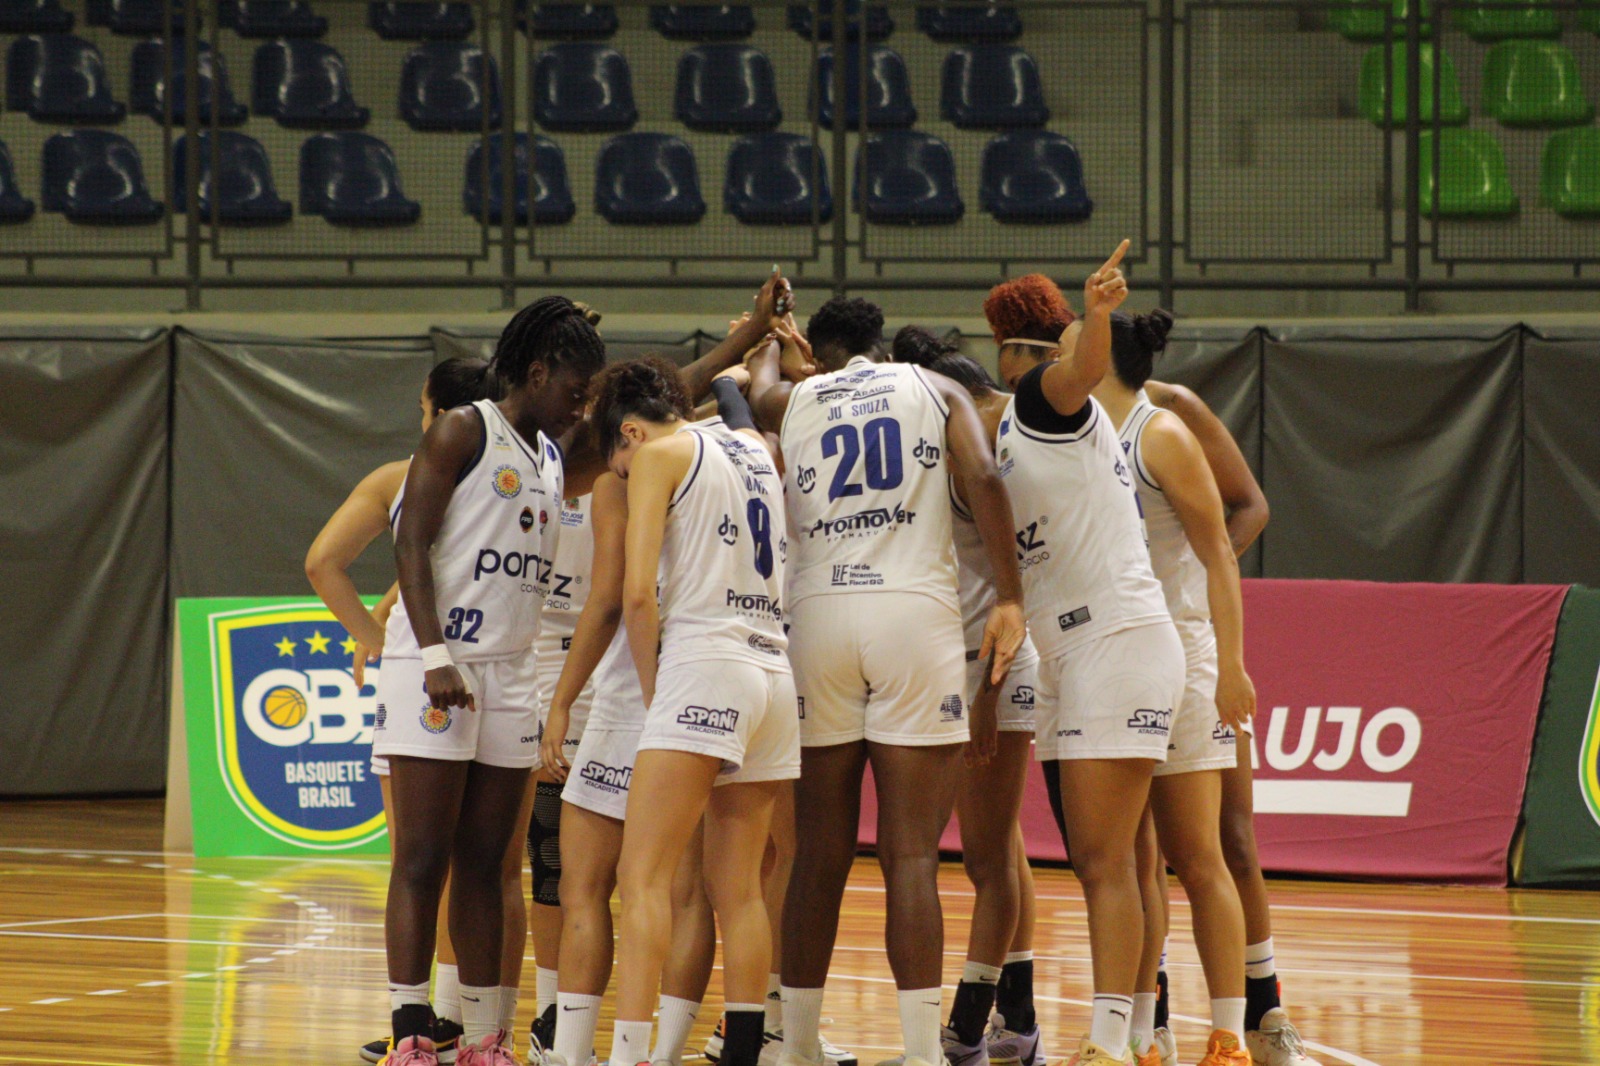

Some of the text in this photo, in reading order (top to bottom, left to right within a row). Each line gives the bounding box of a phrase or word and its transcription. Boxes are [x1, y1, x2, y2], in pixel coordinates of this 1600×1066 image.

[827, 398, 890, 421] JU SOUZA
[821, 417, 903, 504] 20
[444, 607, 483, 643] 32
[686, 725, 725, 736] ATACADISTA
[1250, 706, 1422, 773] UJO
[285, 761, 365, 784] BASQUETE
[298, 787, 355, 808] BRASIL
[585, 780, 620, 795] ATACADISTA
